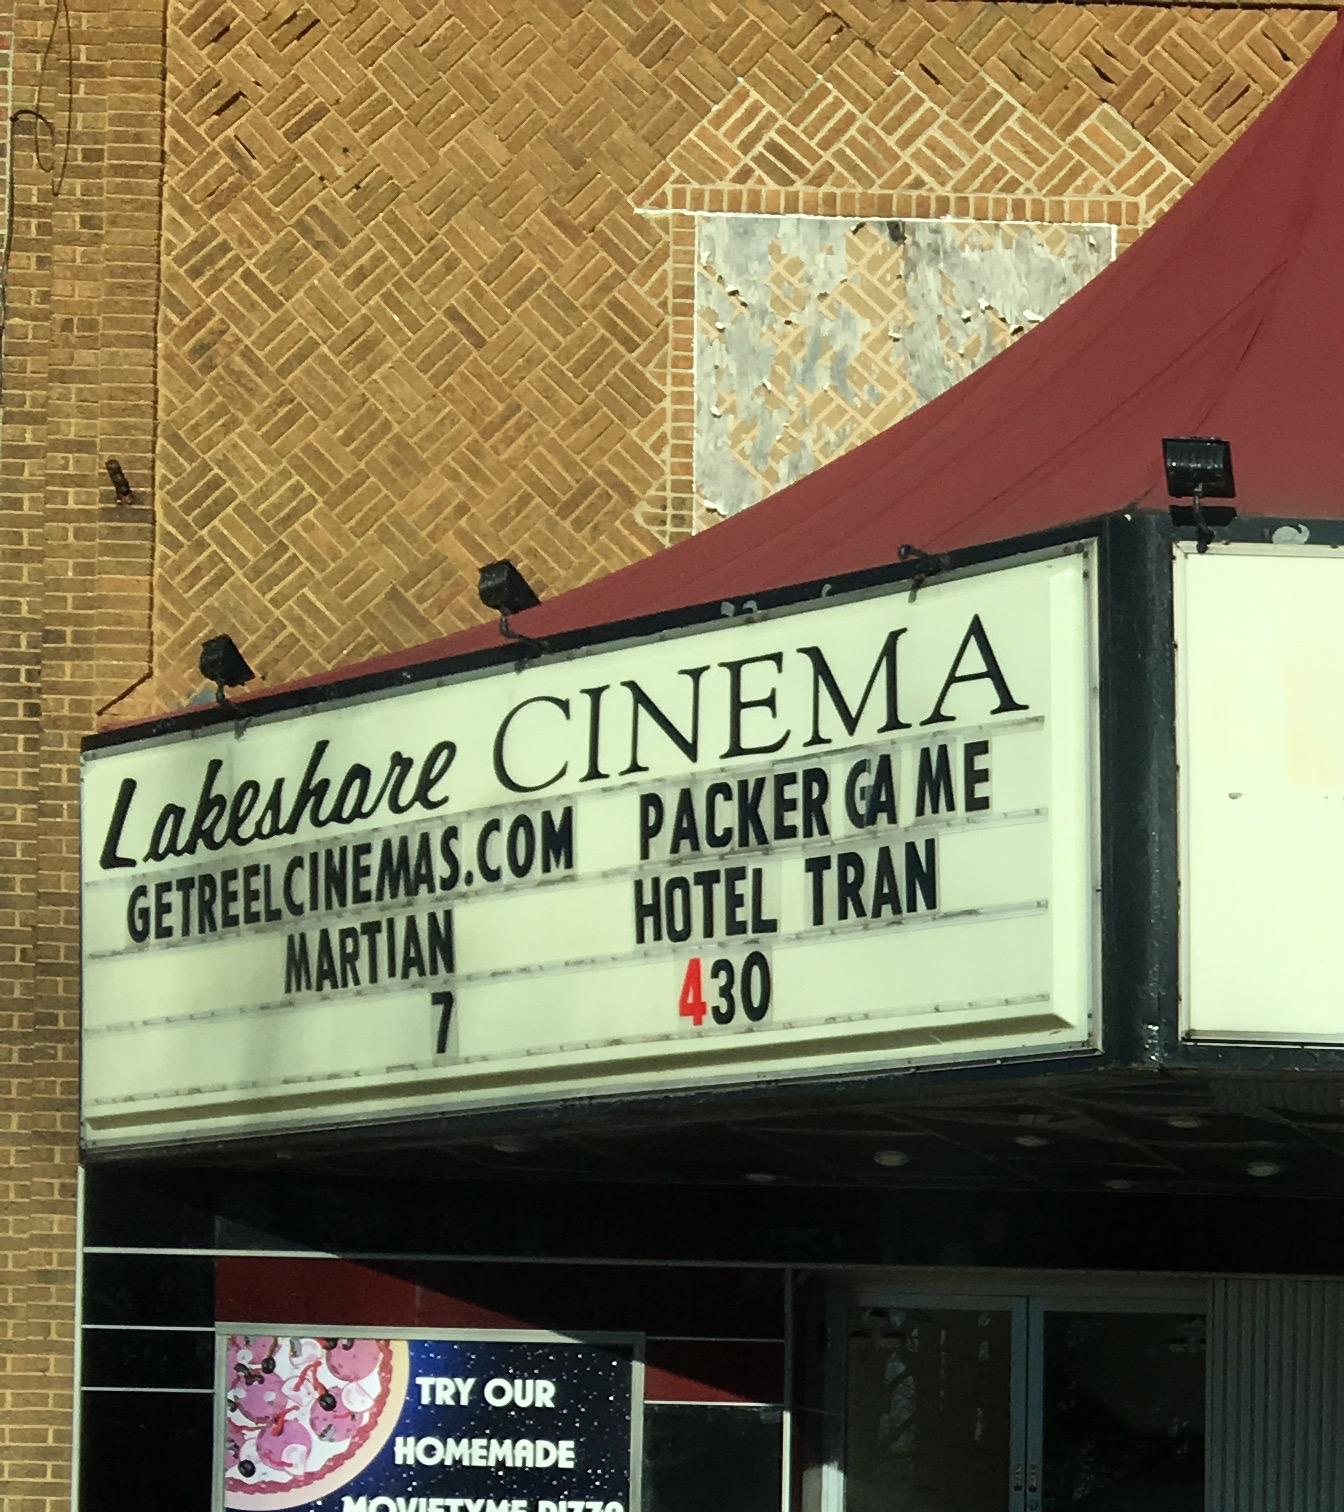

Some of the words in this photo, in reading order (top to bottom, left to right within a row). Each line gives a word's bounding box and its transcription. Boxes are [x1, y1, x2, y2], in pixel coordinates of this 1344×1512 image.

[100, 739, 457, 870] Lakeshore
[493, 613, 1030, 793] CINEMA
[639, 767, 831, 861] PACKER
[846, 741, 990, 829] GAME
[127, 806, 574, 943] GETREELCINEMAS.COM
[635, 865, 778, 944] HOTEL
[805, 838, 937, 926] TRAN
[285, 909, 455, 995] MARTIAN
[678, 951, 772, 1027] 430
[431, 991, 454, 1055] 7
[416, 1377, 475, 1407] TRY
[484, 1377, 555, 1408] OUR
[394, 1436, 575, 1469] HOMEMADE
